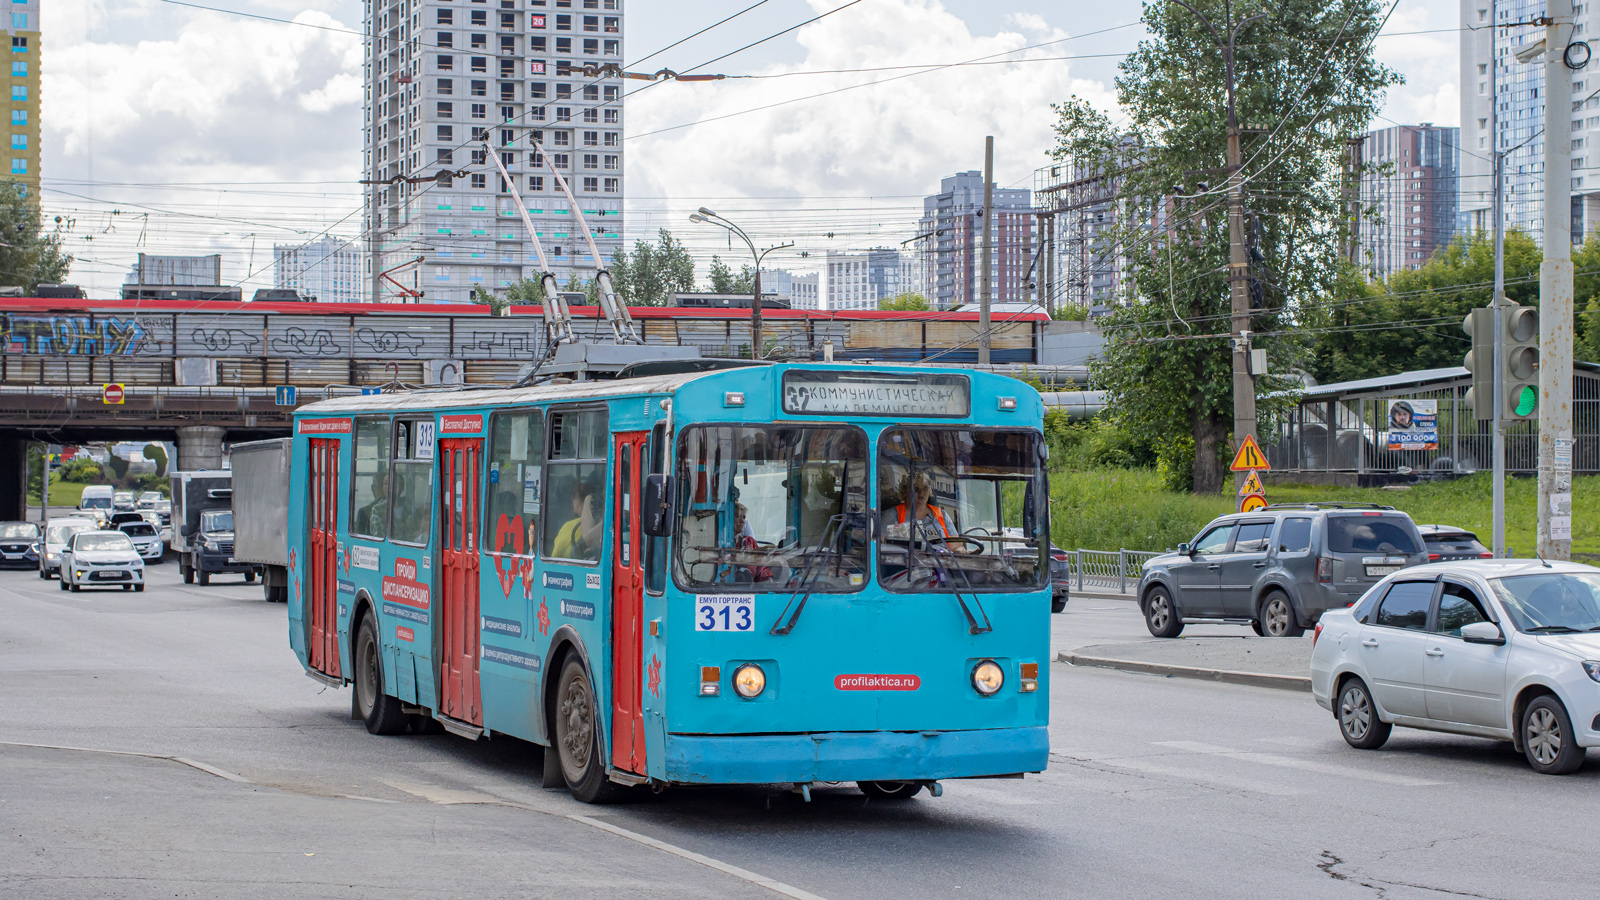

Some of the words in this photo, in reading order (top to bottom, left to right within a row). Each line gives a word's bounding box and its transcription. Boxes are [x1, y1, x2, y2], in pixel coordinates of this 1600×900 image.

[533, 18, 544, 26] 20
[787, 386, 809, 410] 32
[810, 386, 954, 402] КОММУНИСТИЧЕСКАЯ
[445, 419, 463, 429] Бесплатно!
[463, 419, 482, 431] Доступно!
[420, 424, 433, 447] 313
[397, 561, 415, 581] ПРОЙДИ
[587, 575, 600, 585] ВЫХОД
[383, 581, 429, 604] ДИСПАНСЕРИЗАЦИЮ
[566, 602, 593, 617] флюорография
[699, 605, 752, 630] 313
[486, 620, 506, 630] медицинские
[507, 624, 520, 633] анализы
[841, 676, 914, 688] profilaktica.ru
